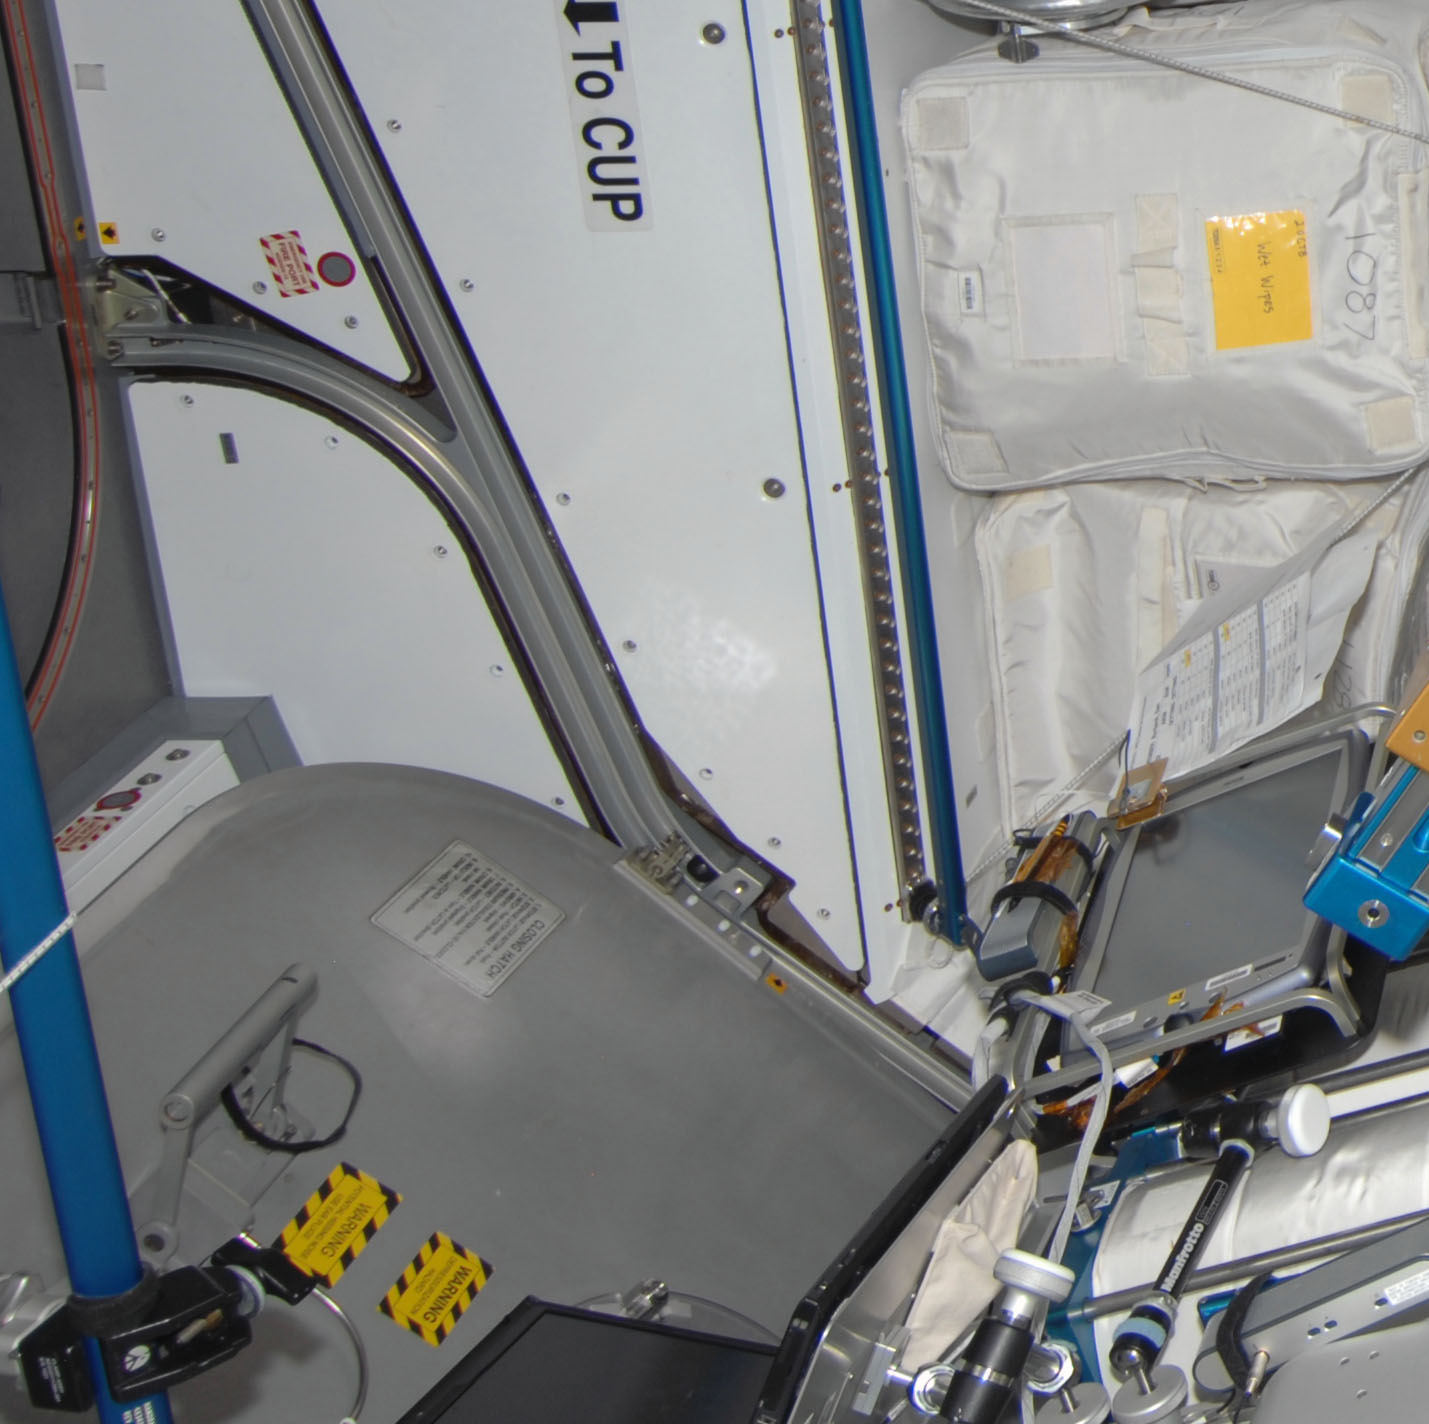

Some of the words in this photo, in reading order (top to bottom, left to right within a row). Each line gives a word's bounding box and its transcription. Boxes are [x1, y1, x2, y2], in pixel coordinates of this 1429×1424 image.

[568, 39, 628, 102] To
[576, 113, 644, 226] CUP
[277, 241, 290, 262] FIRE
[285, 262, 300, 287] PORT
[1256, 240, 1272, 266] Wet
[1255, 275, 1274, 313] Wipes
[1337, 232, 1383, 342] 1087
[483, 947, 516, 981] HATCH
[509, 916, 546, 956] CLOSING
[318, 1197, 373, 1262] WARNING
[1159, 1218, 1206, 1295] Manfrotto
[420, 1262, 473, 1325] WARNING
